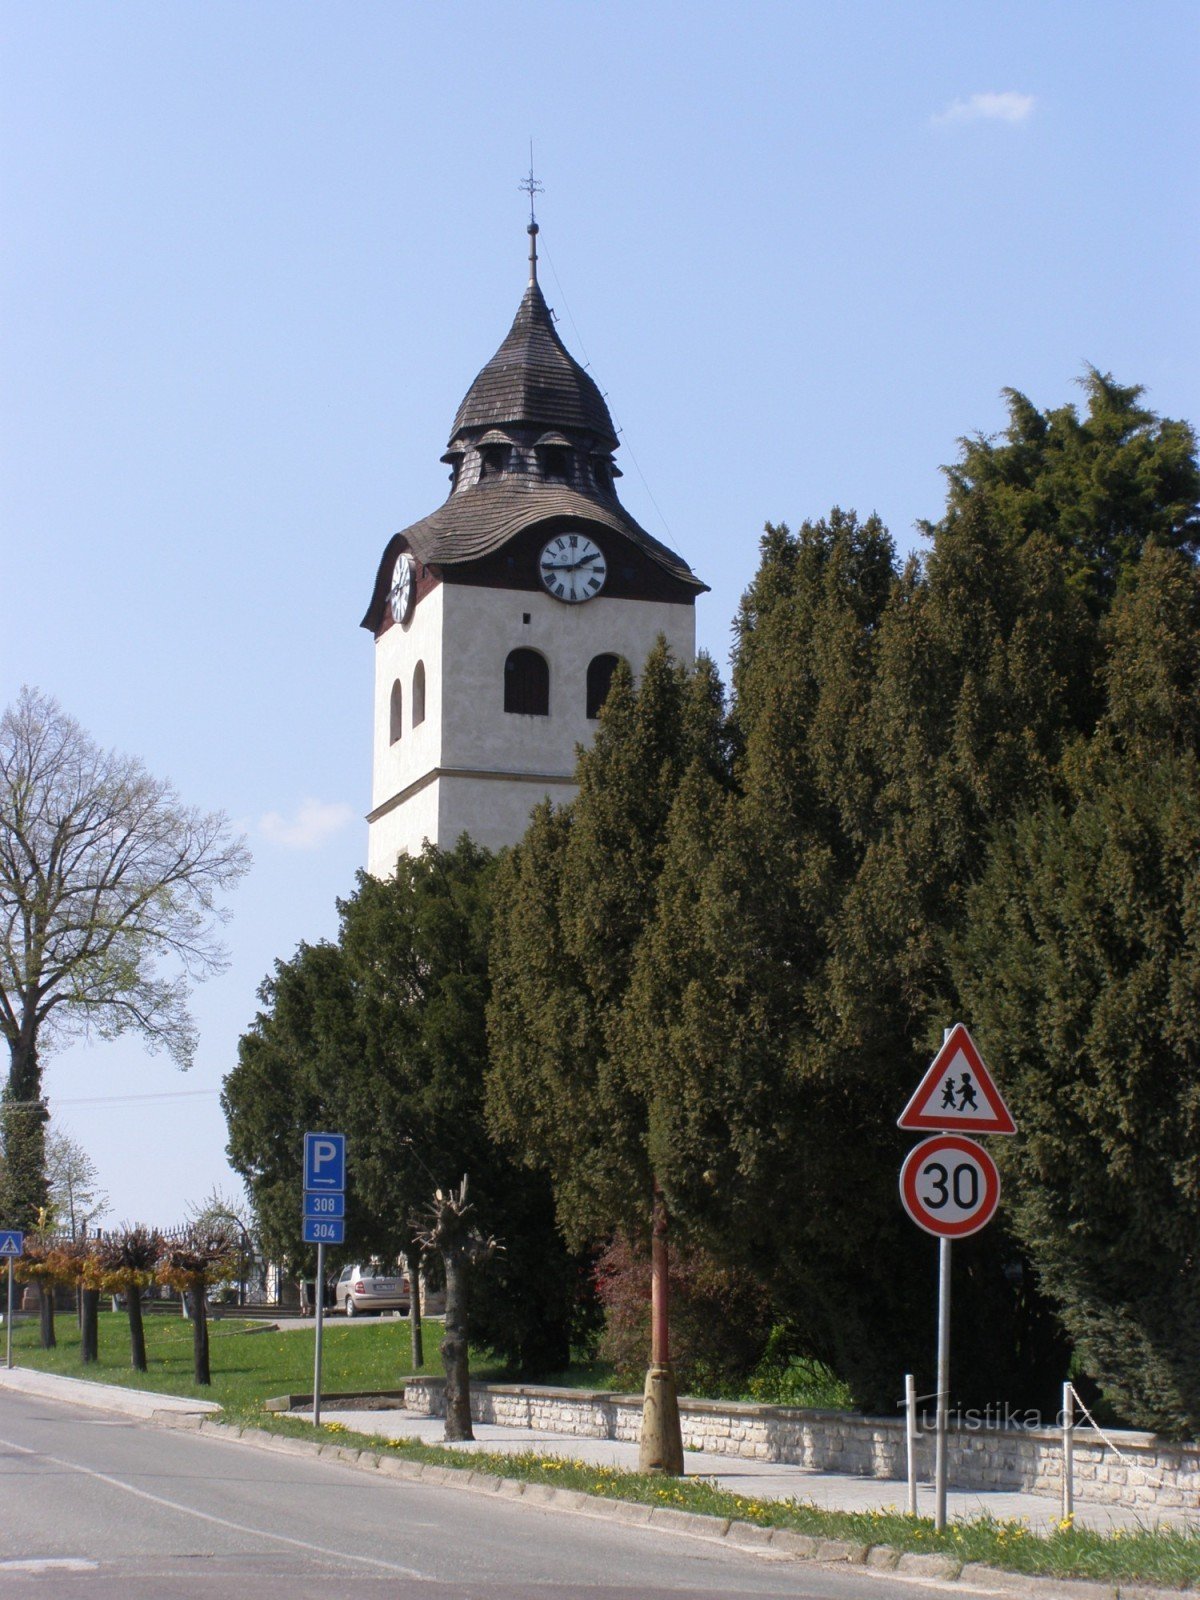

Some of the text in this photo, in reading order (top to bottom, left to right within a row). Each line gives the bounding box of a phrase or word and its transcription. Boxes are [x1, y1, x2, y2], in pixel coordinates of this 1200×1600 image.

[313, 1140, 336, 1173] P
[923, 1163, 979, 1210] 30
[314, 1198, 335, 1212] 308
[313, 1224, 335, 1238] 304
